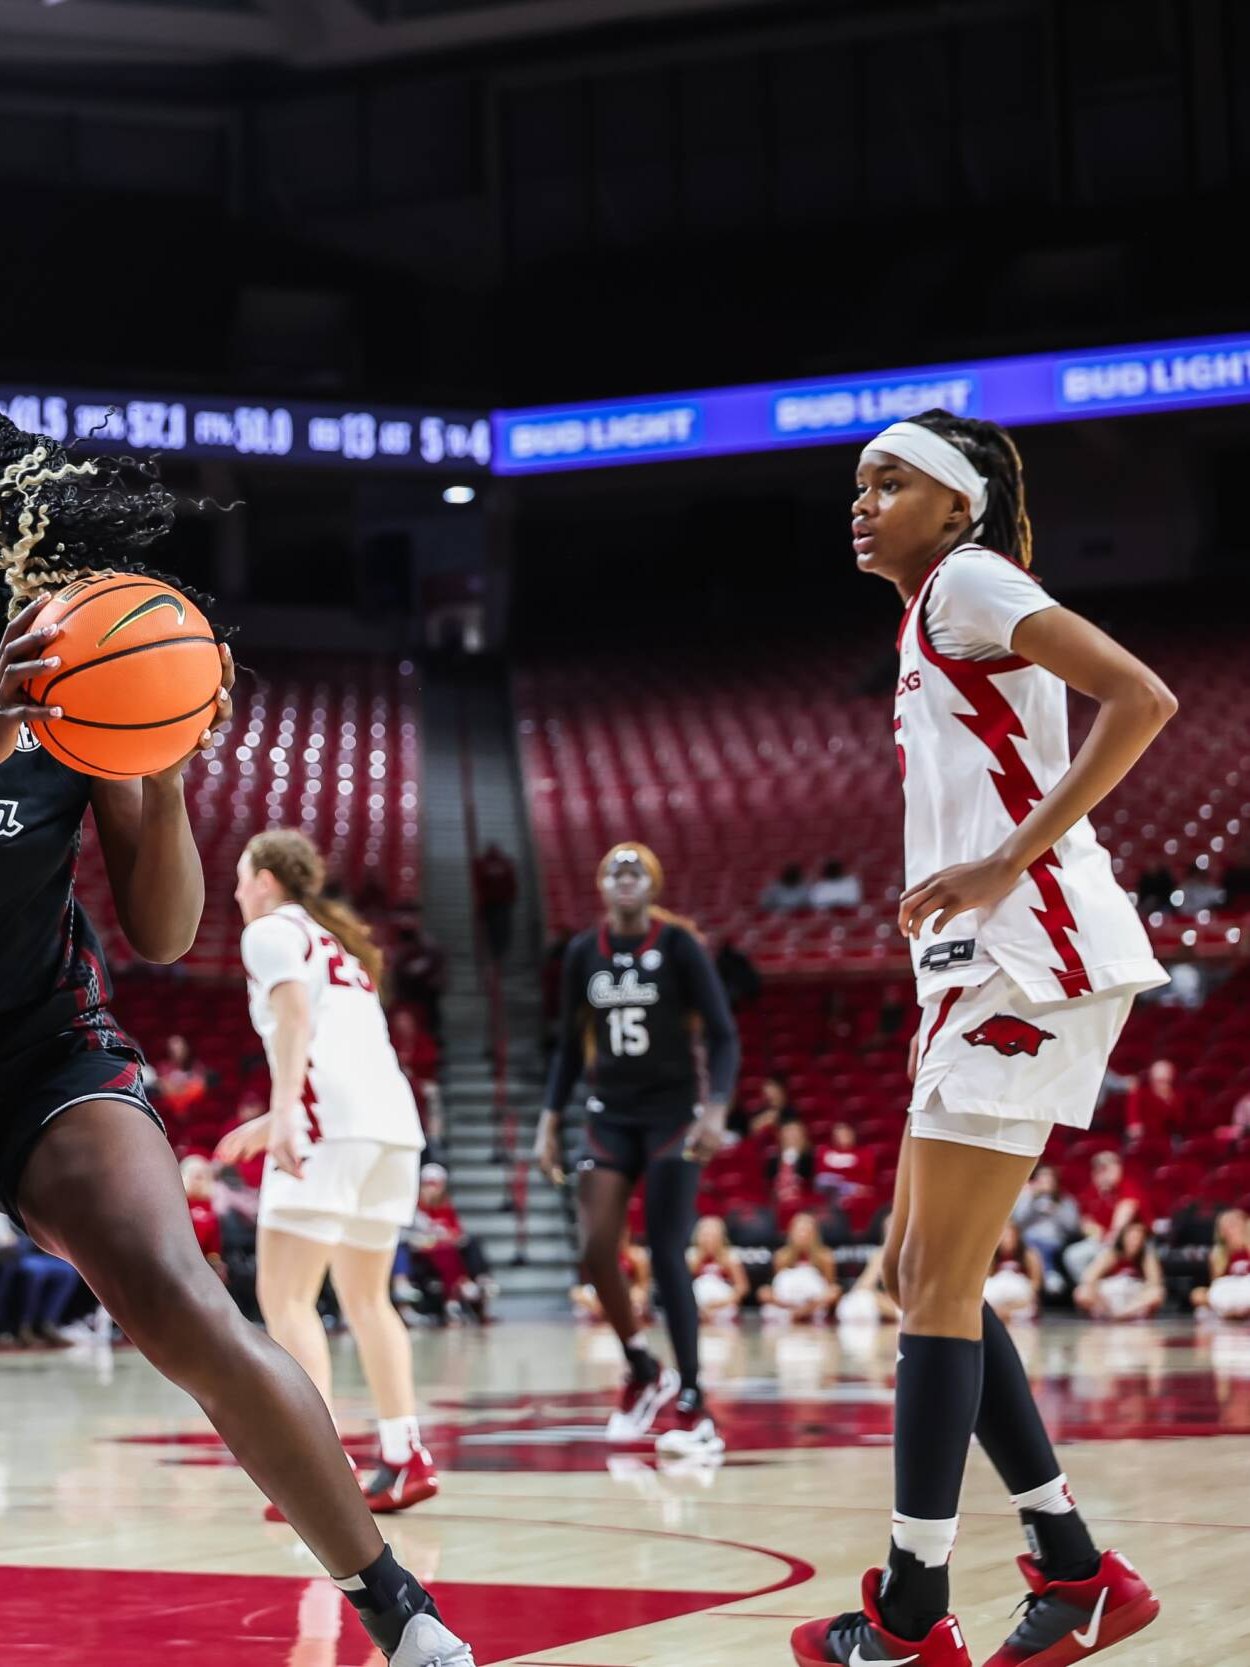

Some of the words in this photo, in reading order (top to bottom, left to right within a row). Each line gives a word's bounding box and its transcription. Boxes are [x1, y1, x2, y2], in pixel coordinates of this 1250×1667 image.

[1063, 366, 1148, 402] BUD
[1152, 350, 1250, 394] LIGH
[776, 391, 854, 432] BUD
[860, 379, 972, 424] LIGHT
[420, 416, 445, 464] 5
[510, 420, 586, 460] BUD
[588, 408, 695, 452] LIGHT
[606, 1006, 650, 1057] 15
